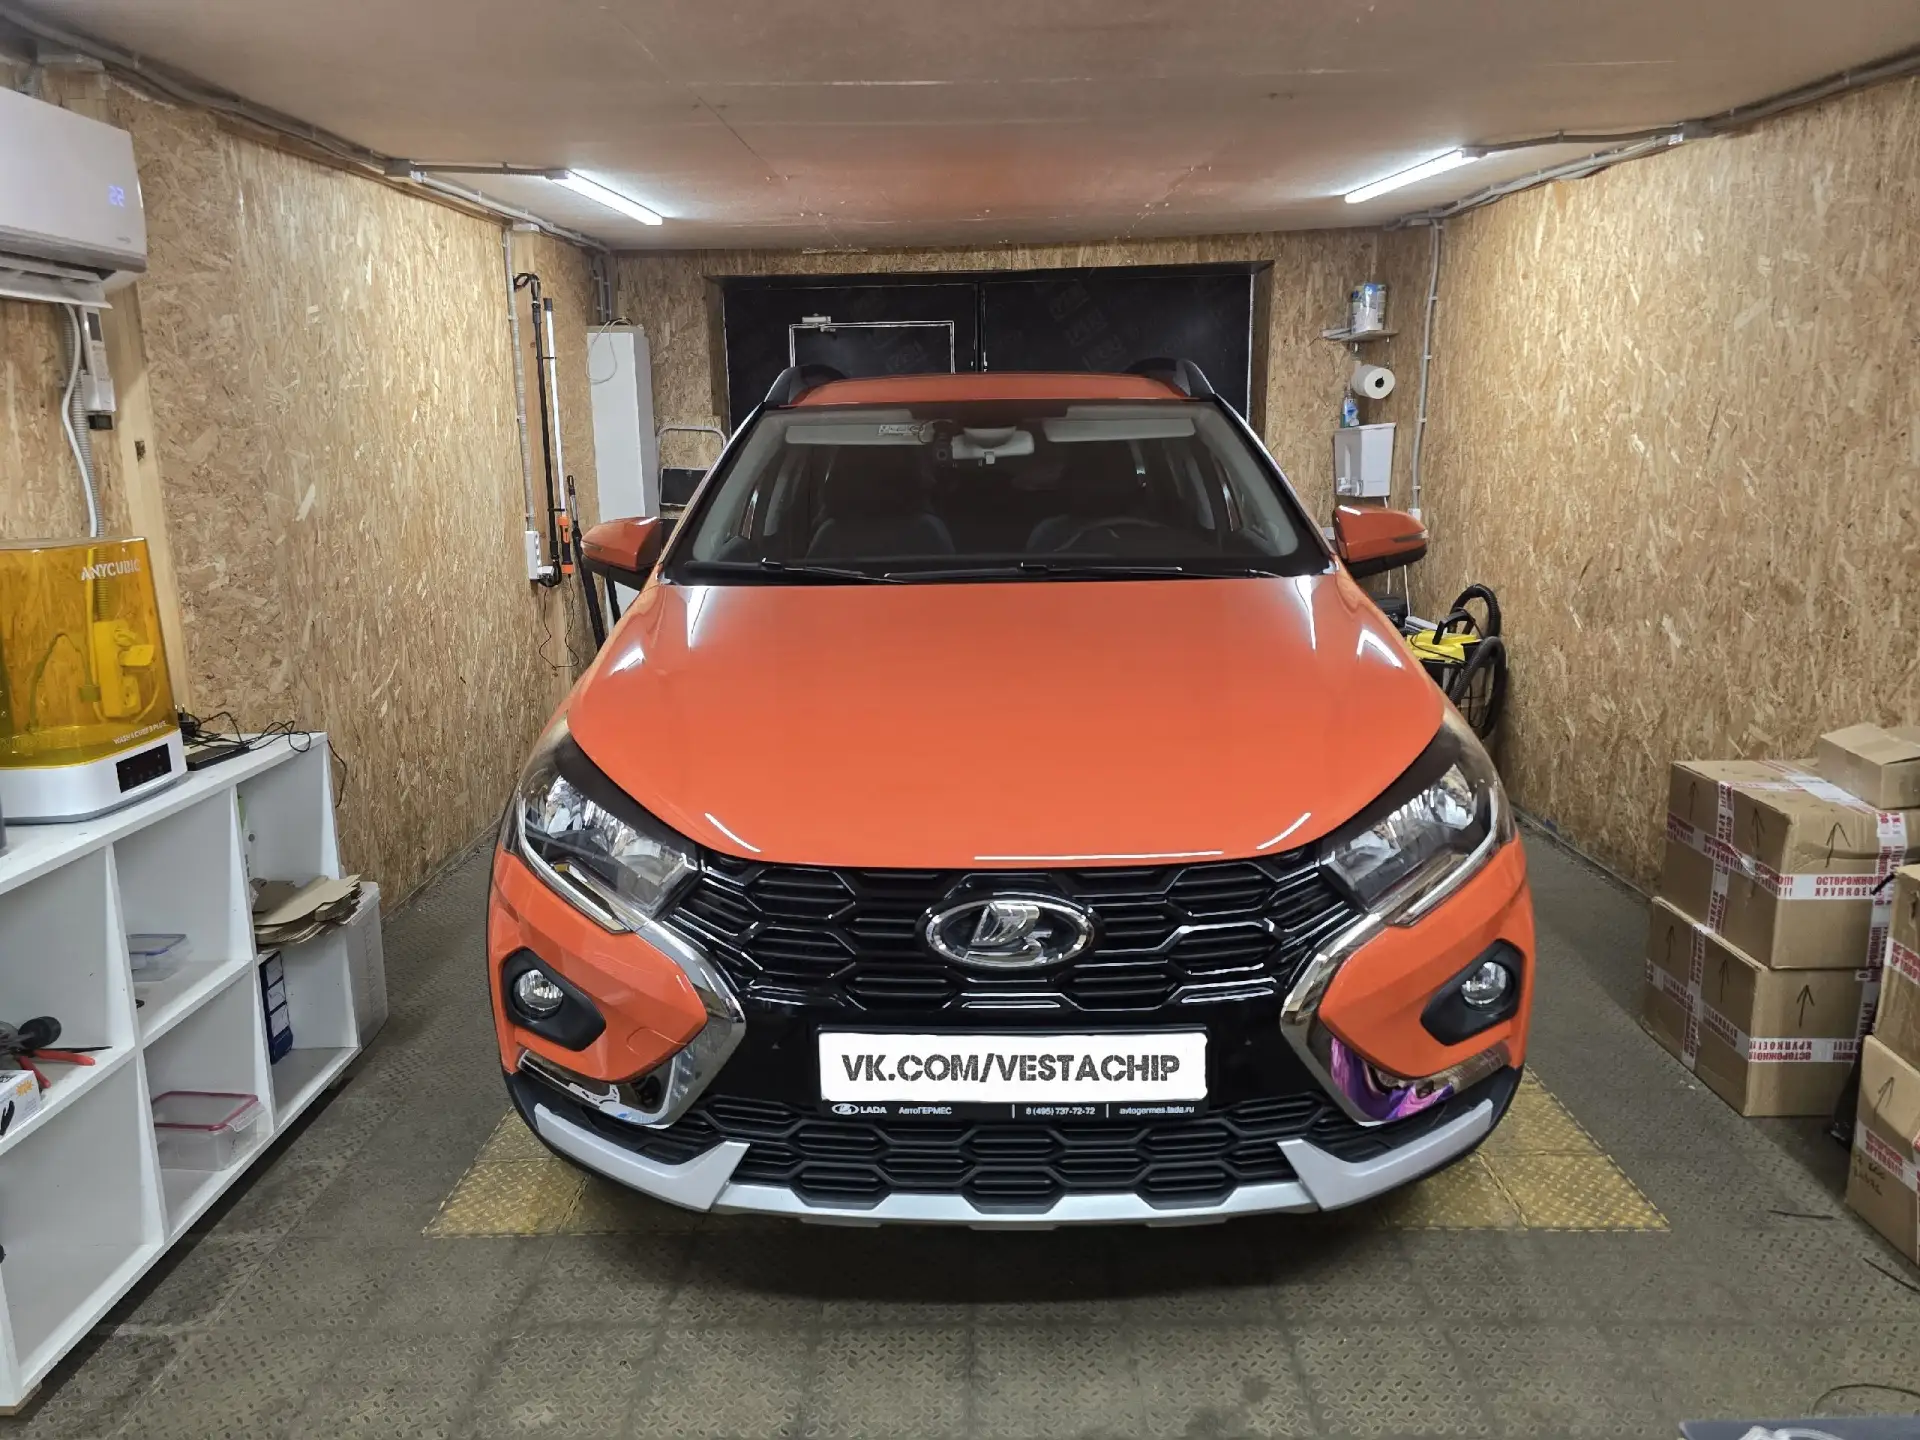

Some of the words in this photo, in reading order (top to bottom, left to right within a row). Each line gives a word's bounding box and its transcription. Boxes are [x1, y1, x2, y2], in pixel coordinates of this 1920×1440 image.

[81, 559, 140, 580] ANYCUBIC
[860, 1106, 887, 1114] LADA
[898, 1106, 952, 1115] АвтоГЕРМЕС
[1026, 1106, 1031, 1115] 8
[1033, 1106, 1054, 1116] (495)
[1055, 1106, 1096, 1115] 737-72-72
[1119, 1106, 1195, 1116] avtogermes.lada.ru
